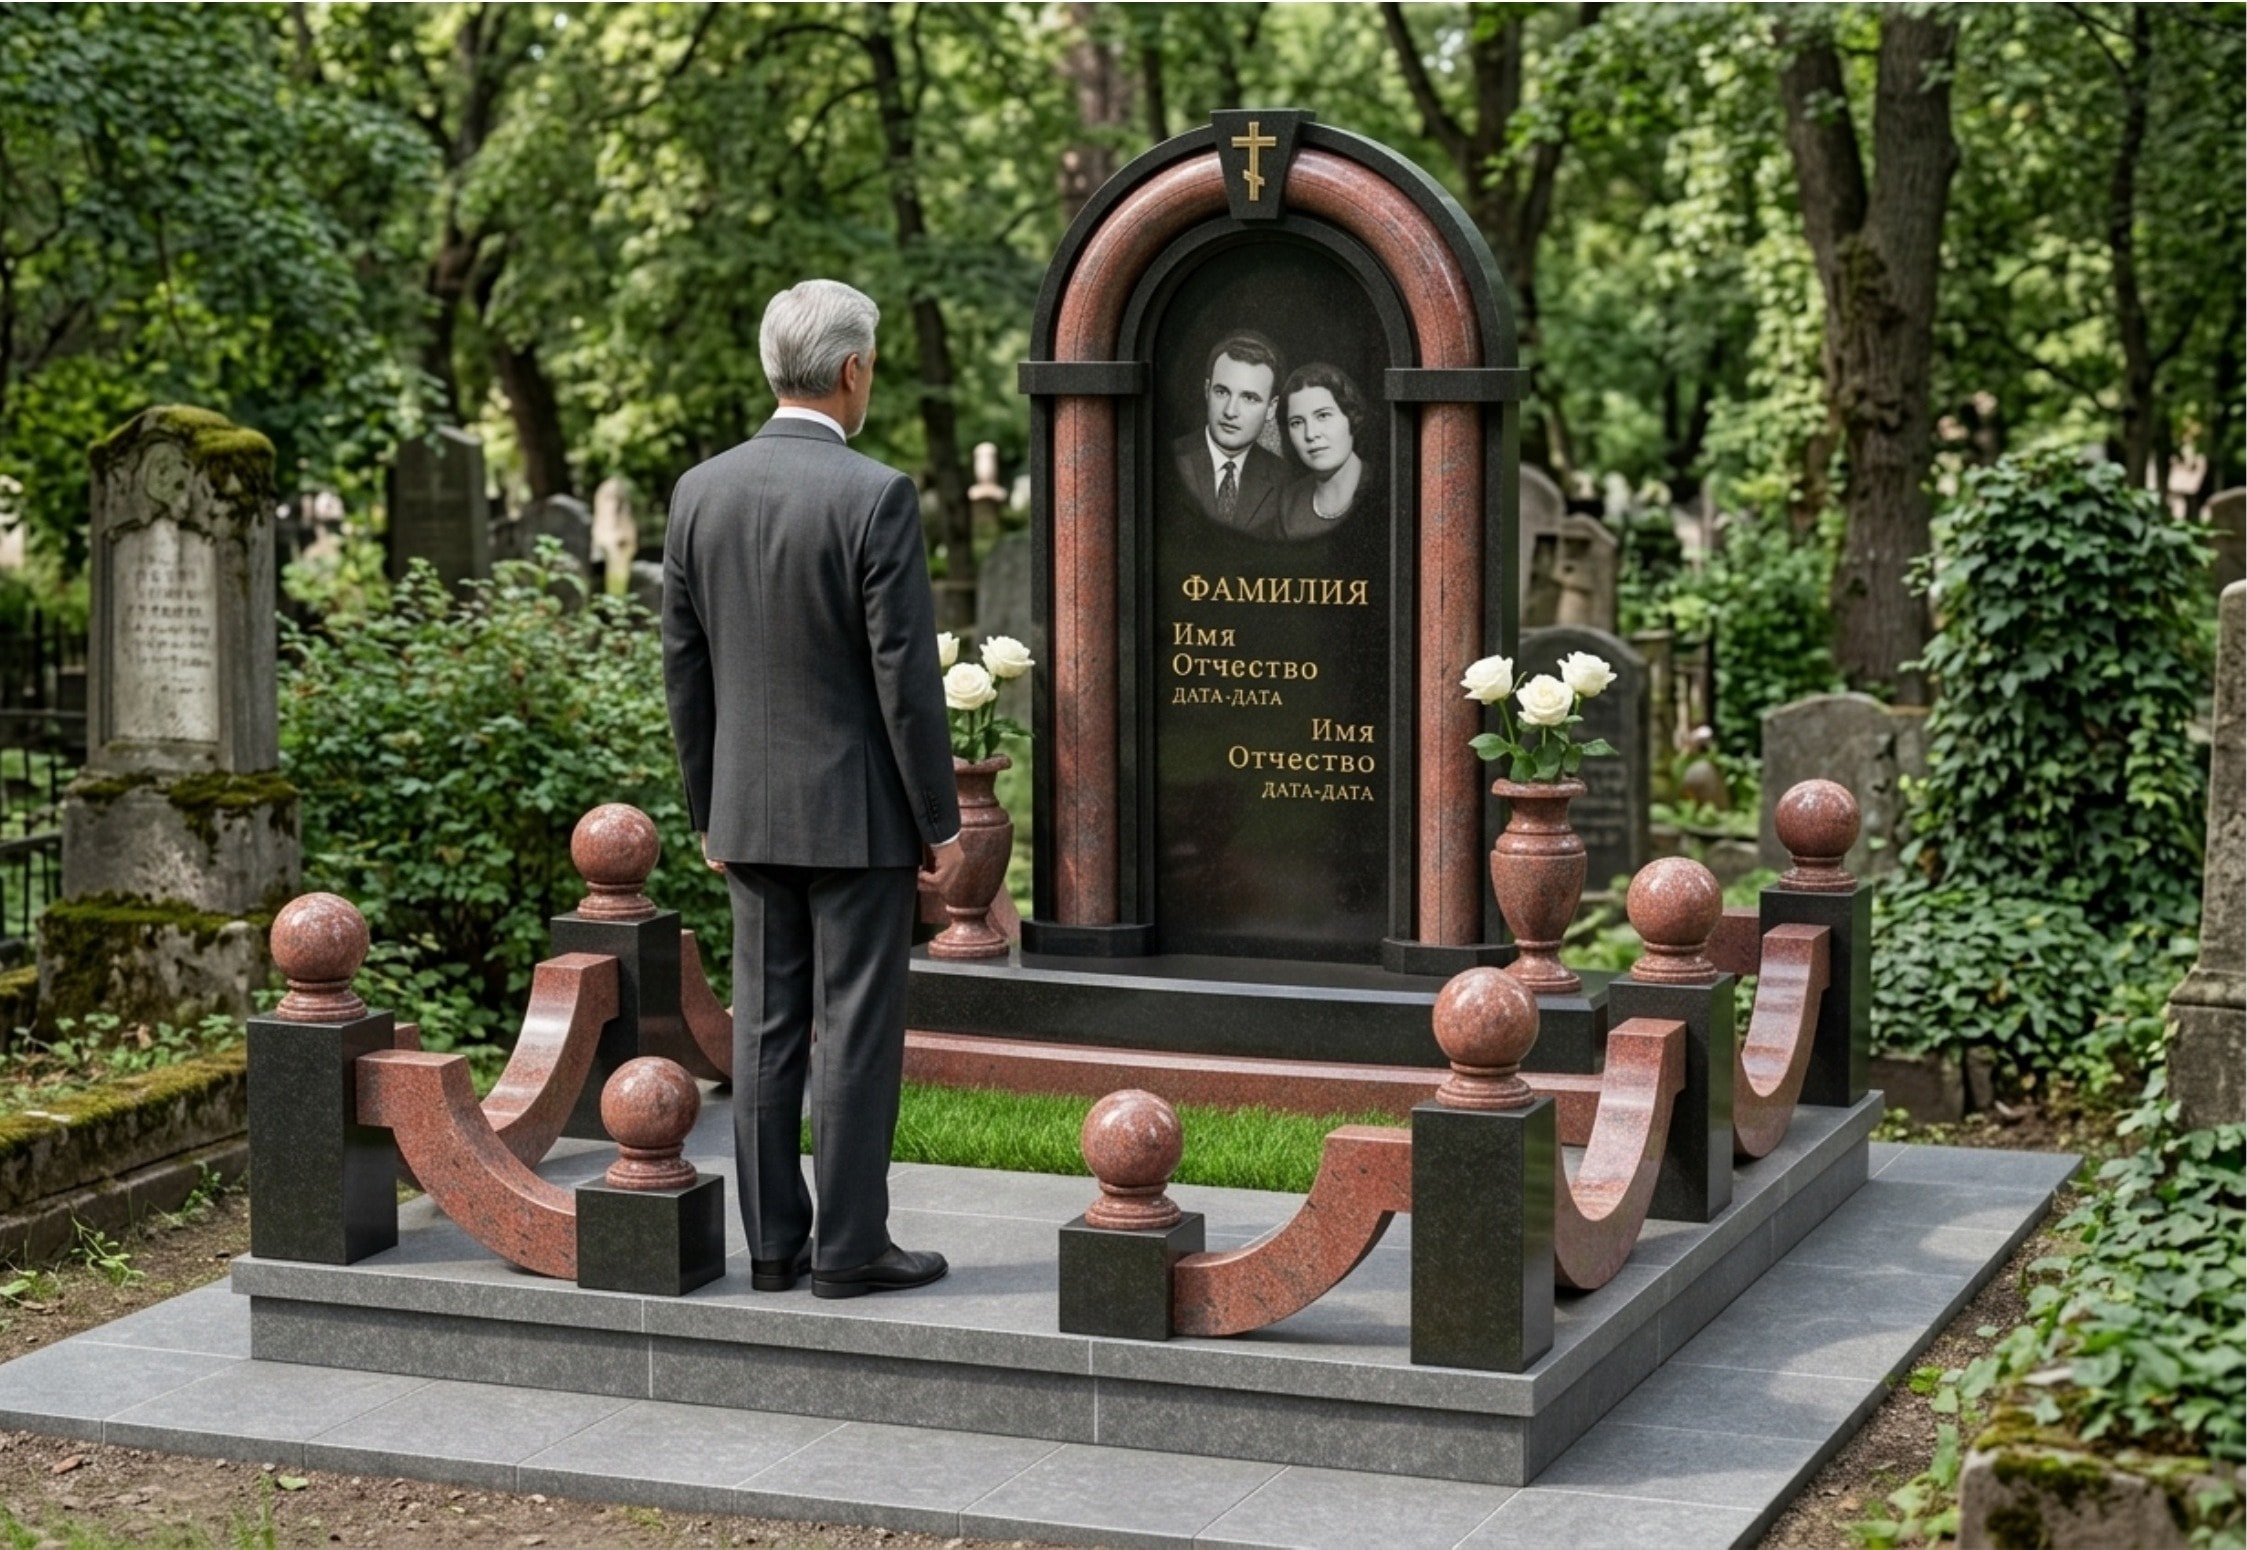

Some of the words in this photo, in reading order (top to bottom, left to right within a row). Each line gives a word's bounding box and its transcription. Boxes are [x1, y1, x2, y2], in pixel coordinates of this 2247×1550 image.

[1181, 574, 1369, 605] ФАМИЛИЯ
[1172, 621, 1236, 647] Имя
[1172, 652, 1318, 680] Отчество
[1171, 687, 1283, 707] ДАТА-ДАТА
[1311, 718, 1375, 743] Имя
[1228, 745, 1375, 773] Отчество
[1261, 781, 1375, 802] ДАТА-ДАТА
